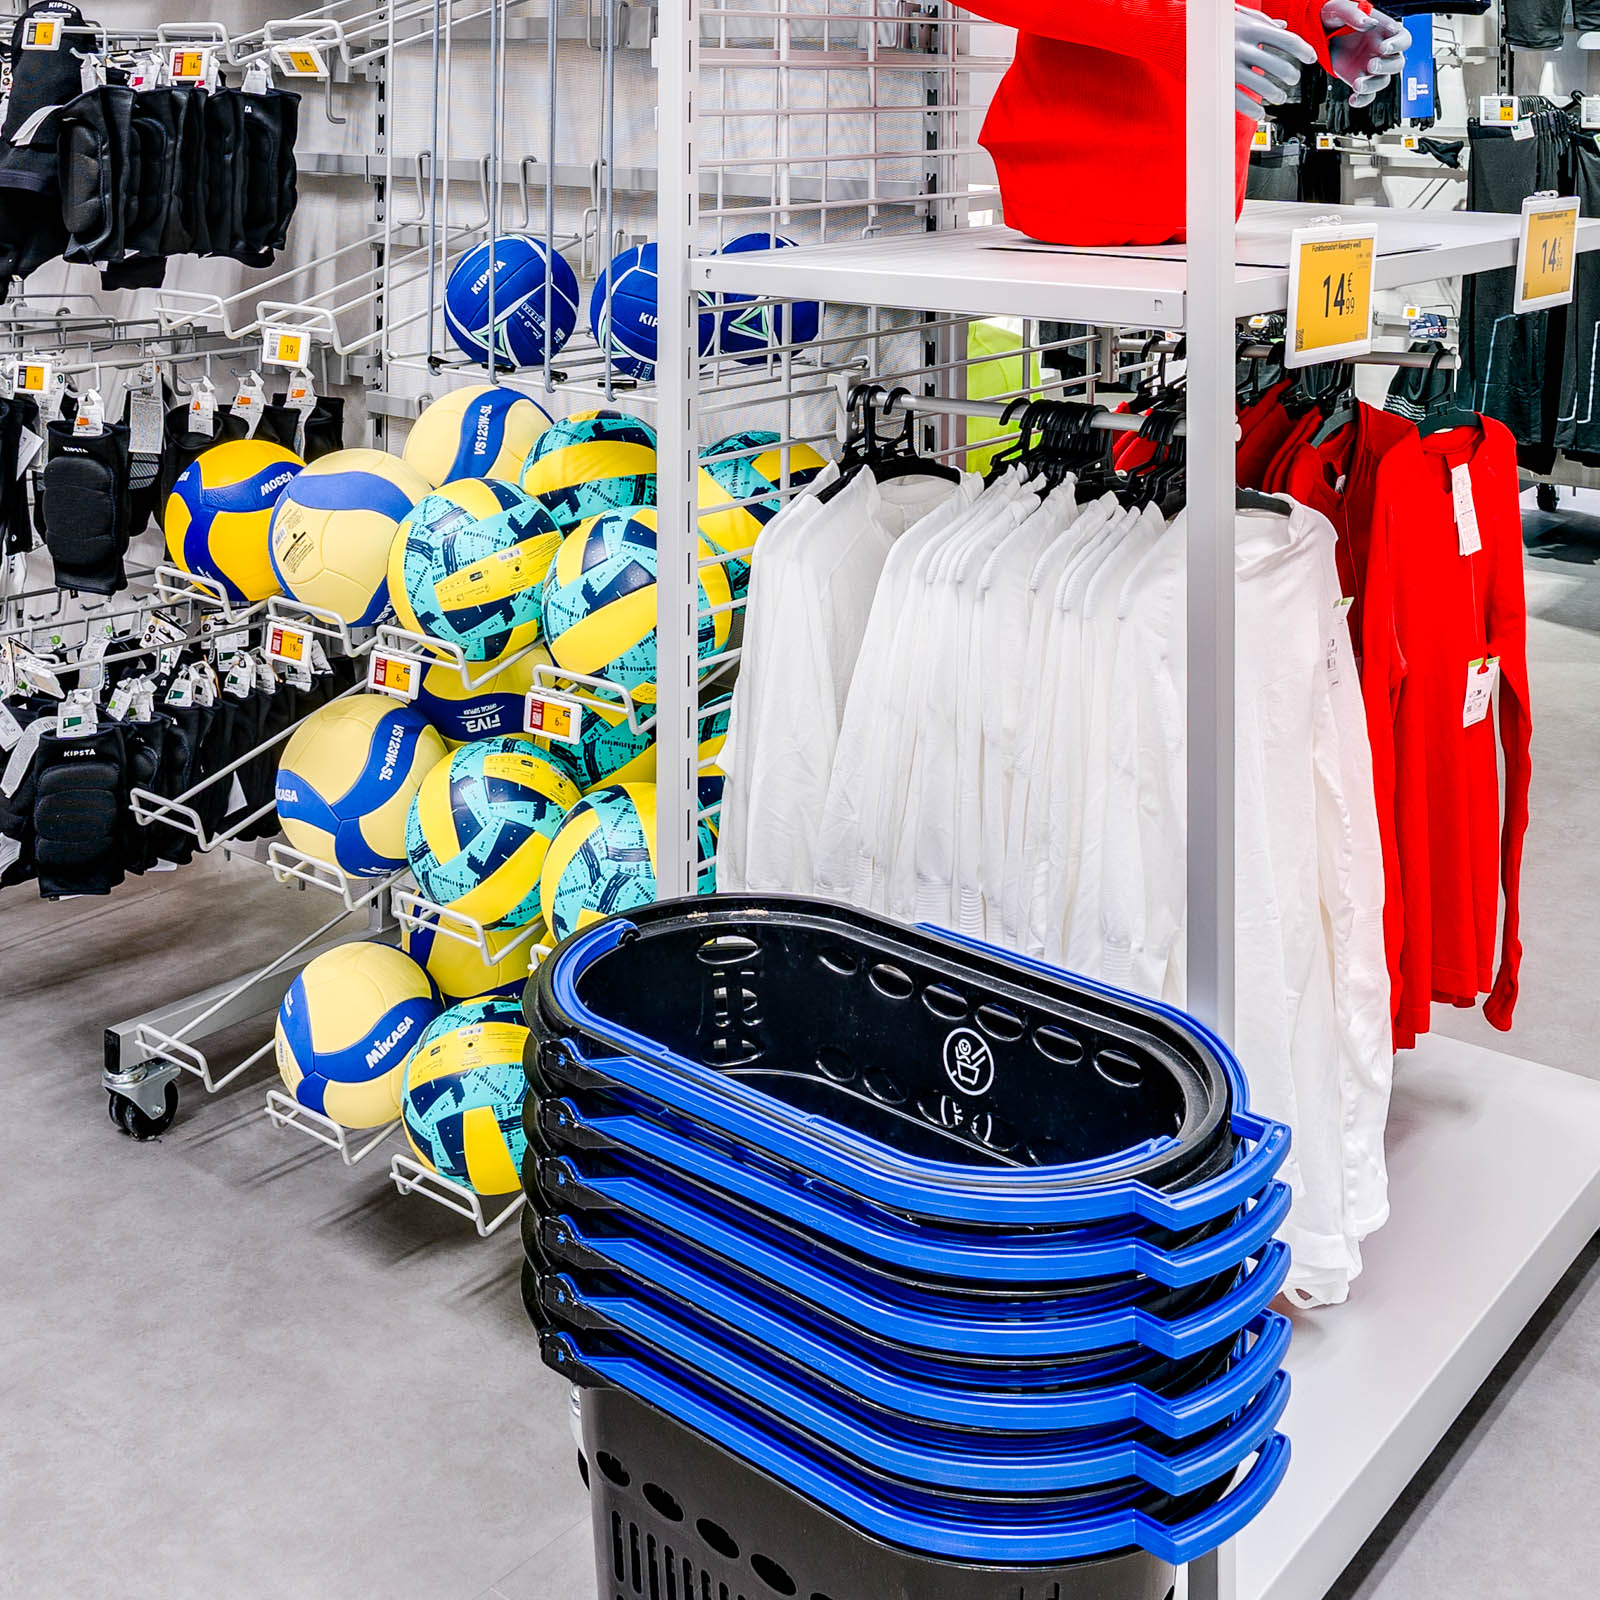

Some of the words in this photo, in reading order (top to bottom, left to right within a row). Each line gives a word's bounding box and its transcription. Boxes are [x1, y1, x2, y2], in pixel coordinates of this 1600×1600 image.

[48, 1, 77, 13] KIPSTA
[473, 403, 493, 456] VS123W-SL
[63, 748, 96, 758] KIPSTA
[378, 724, 405, 781] VS123W-SL
